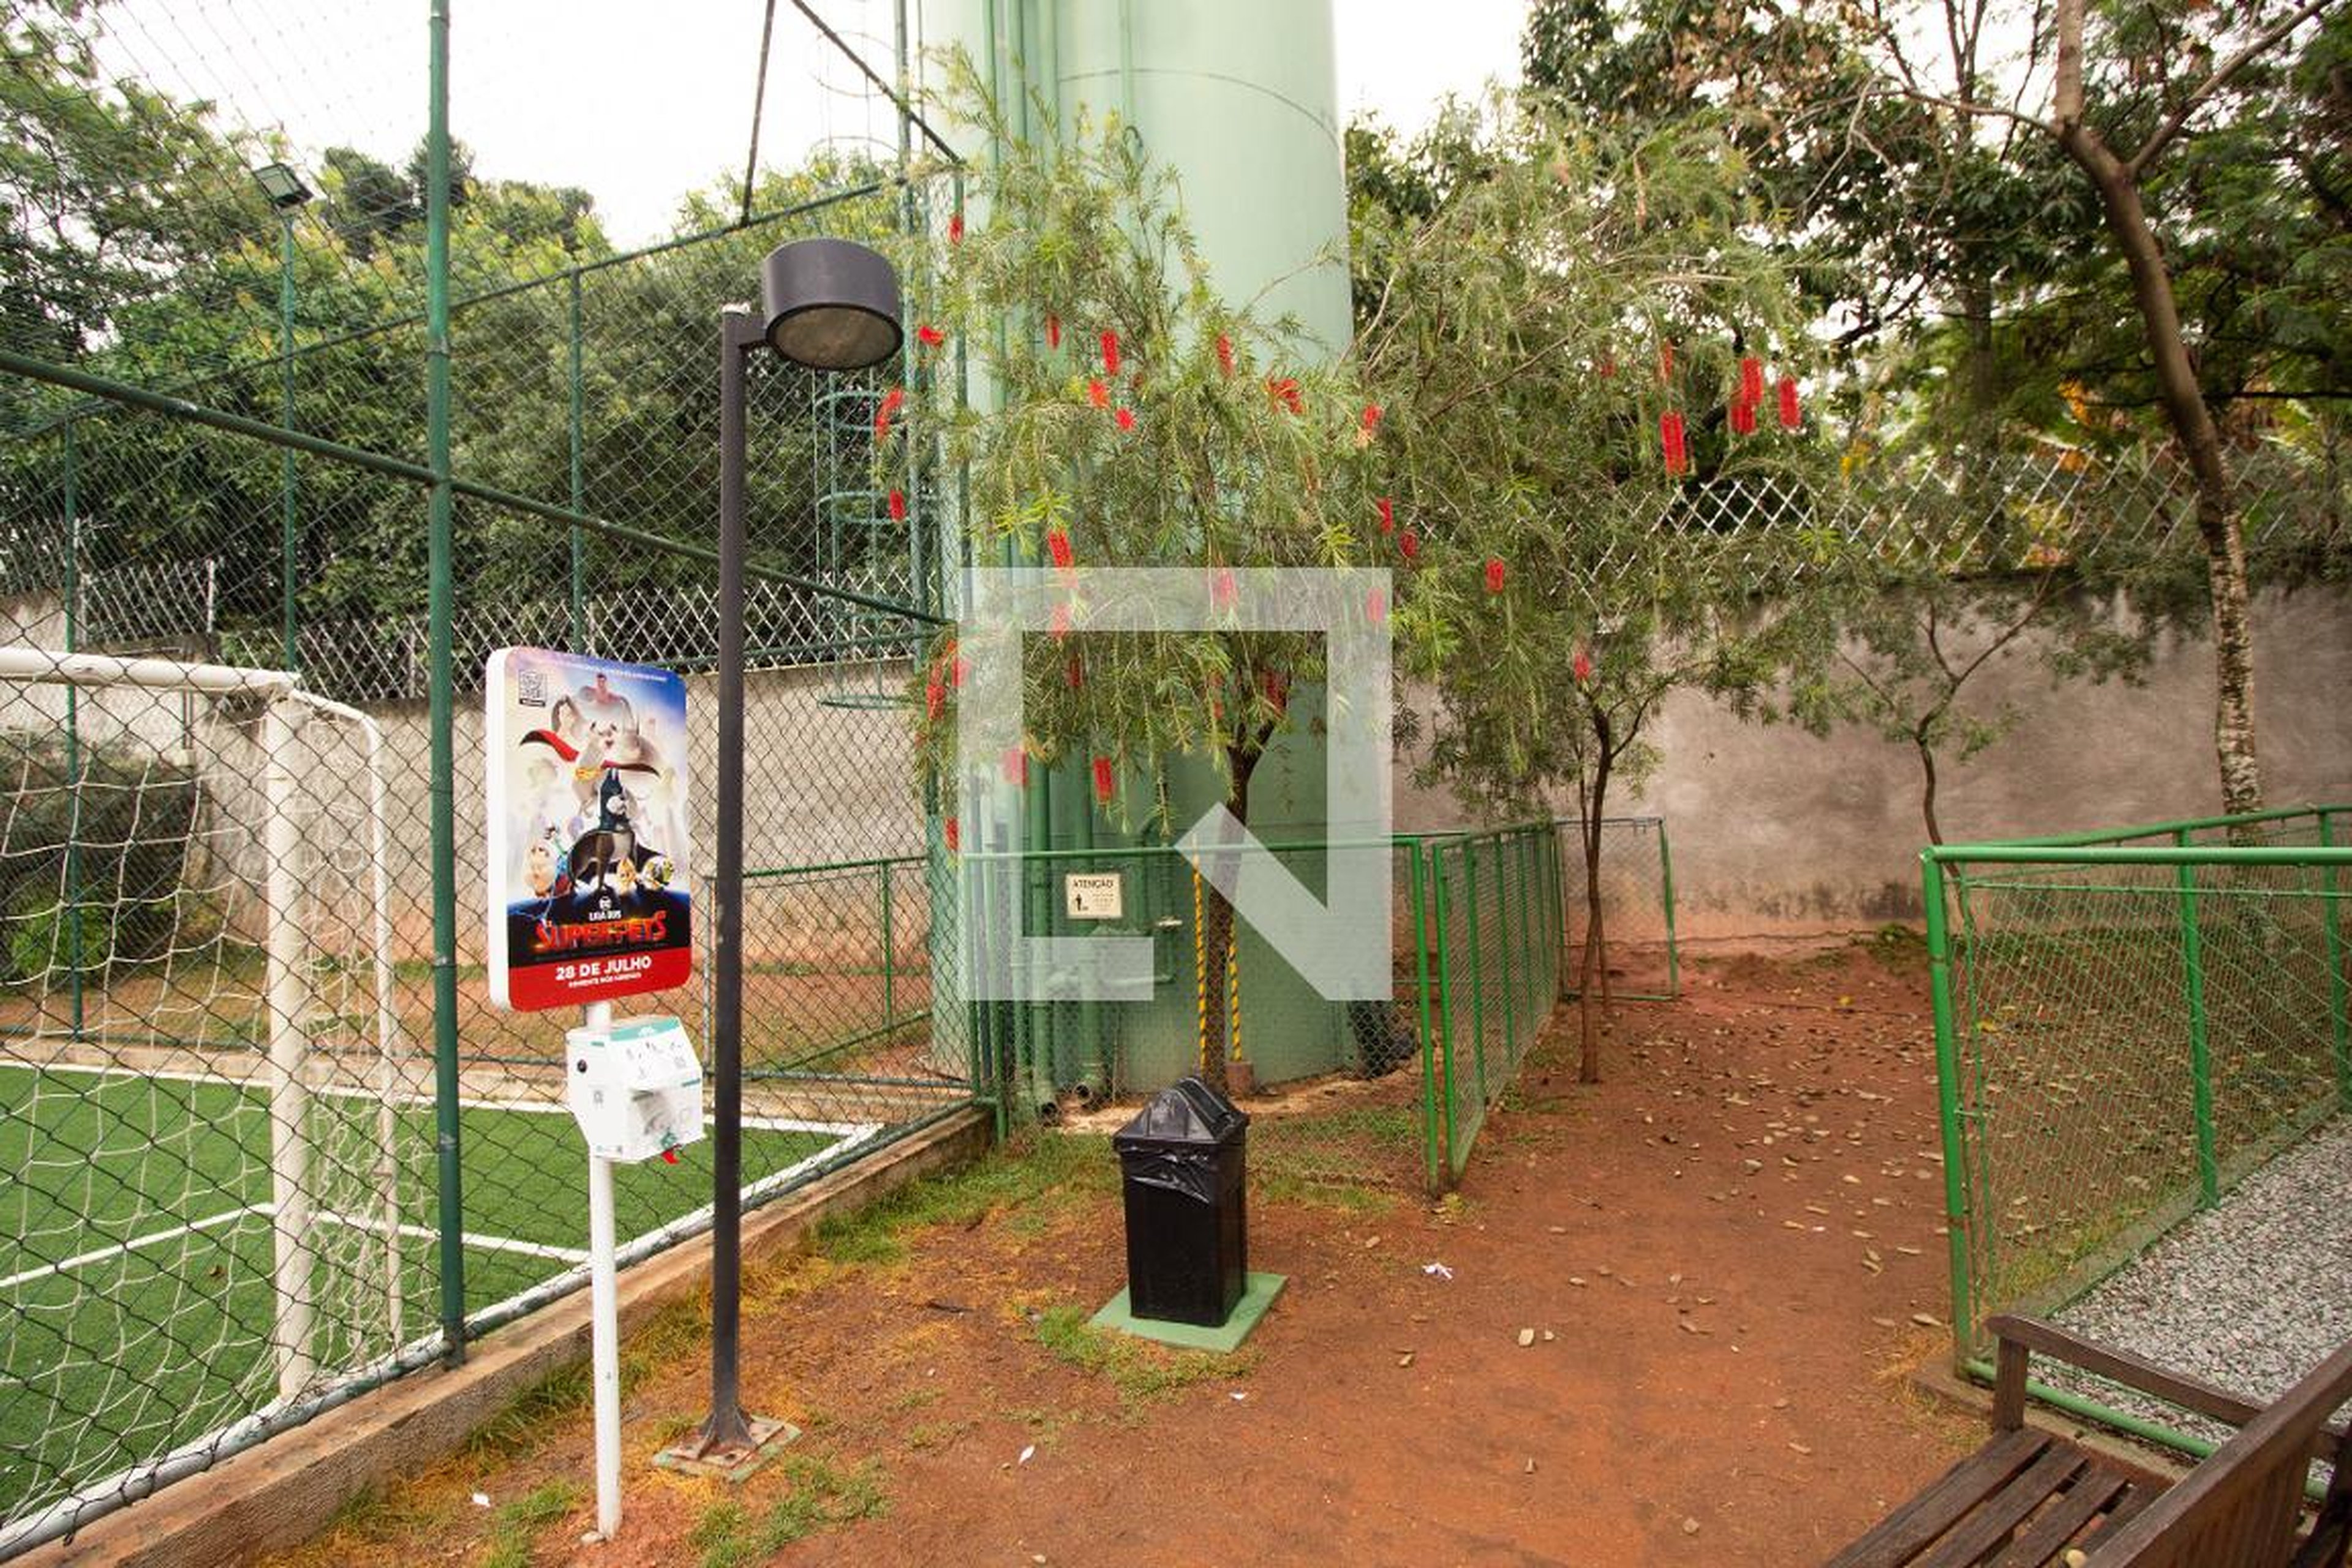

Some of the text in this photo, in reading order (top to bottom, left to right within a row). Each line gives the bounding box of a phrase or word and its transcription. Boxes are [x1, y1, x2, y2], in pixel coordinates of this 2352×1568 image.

[556, 965, 575, 980] 28
[579, 963, 601, 977] DE
[603, 956, 652, 973] JULHO
